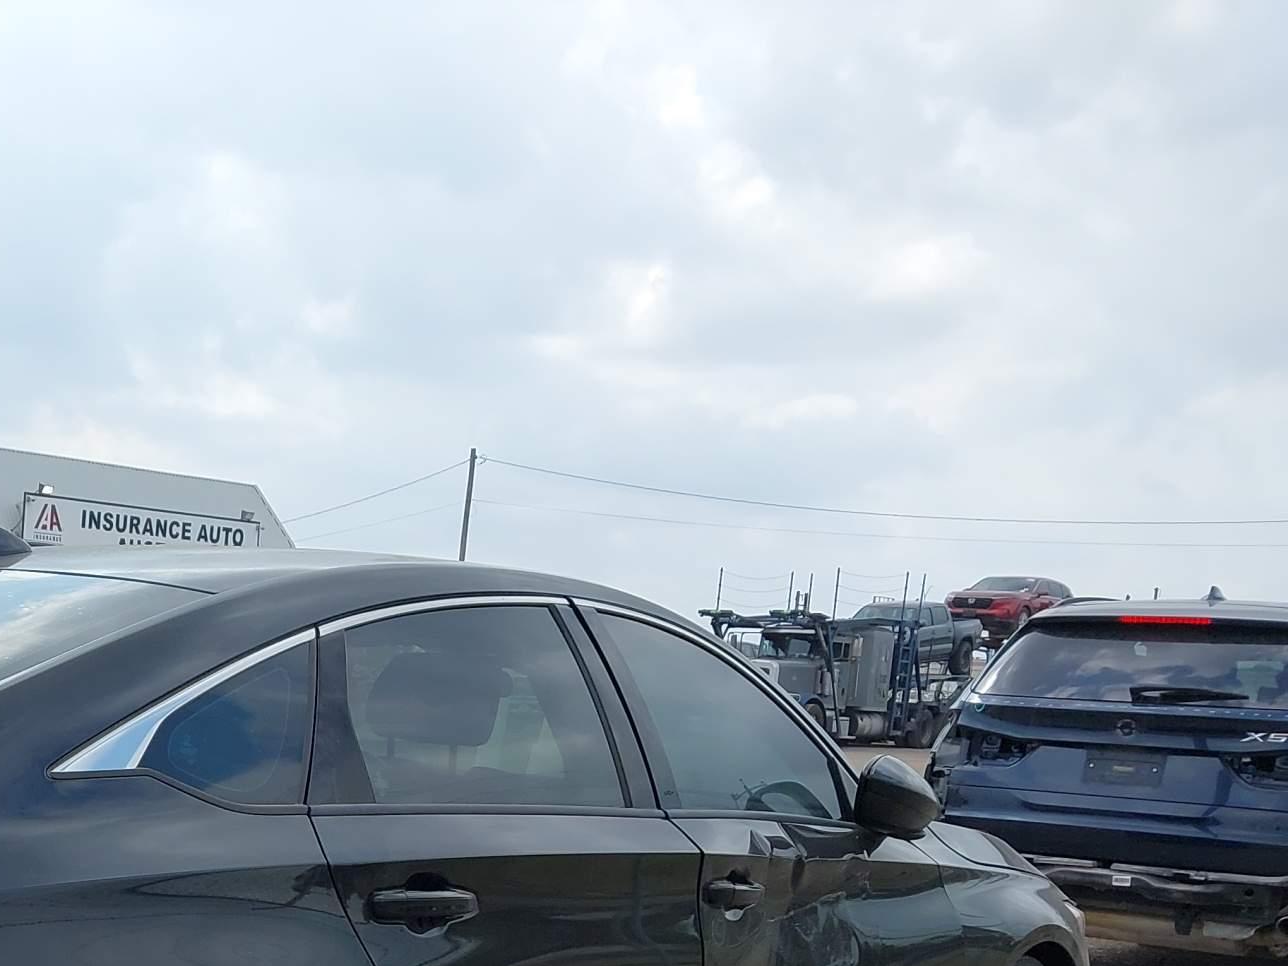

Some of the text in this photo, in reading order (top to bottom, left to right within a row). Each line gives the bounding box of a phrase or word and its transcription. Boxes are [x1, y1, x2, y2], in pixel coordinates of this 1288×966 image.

[81, 509, 244, 546] INSURANCE AUTO
[1240, 732, 1288, 742] X5
